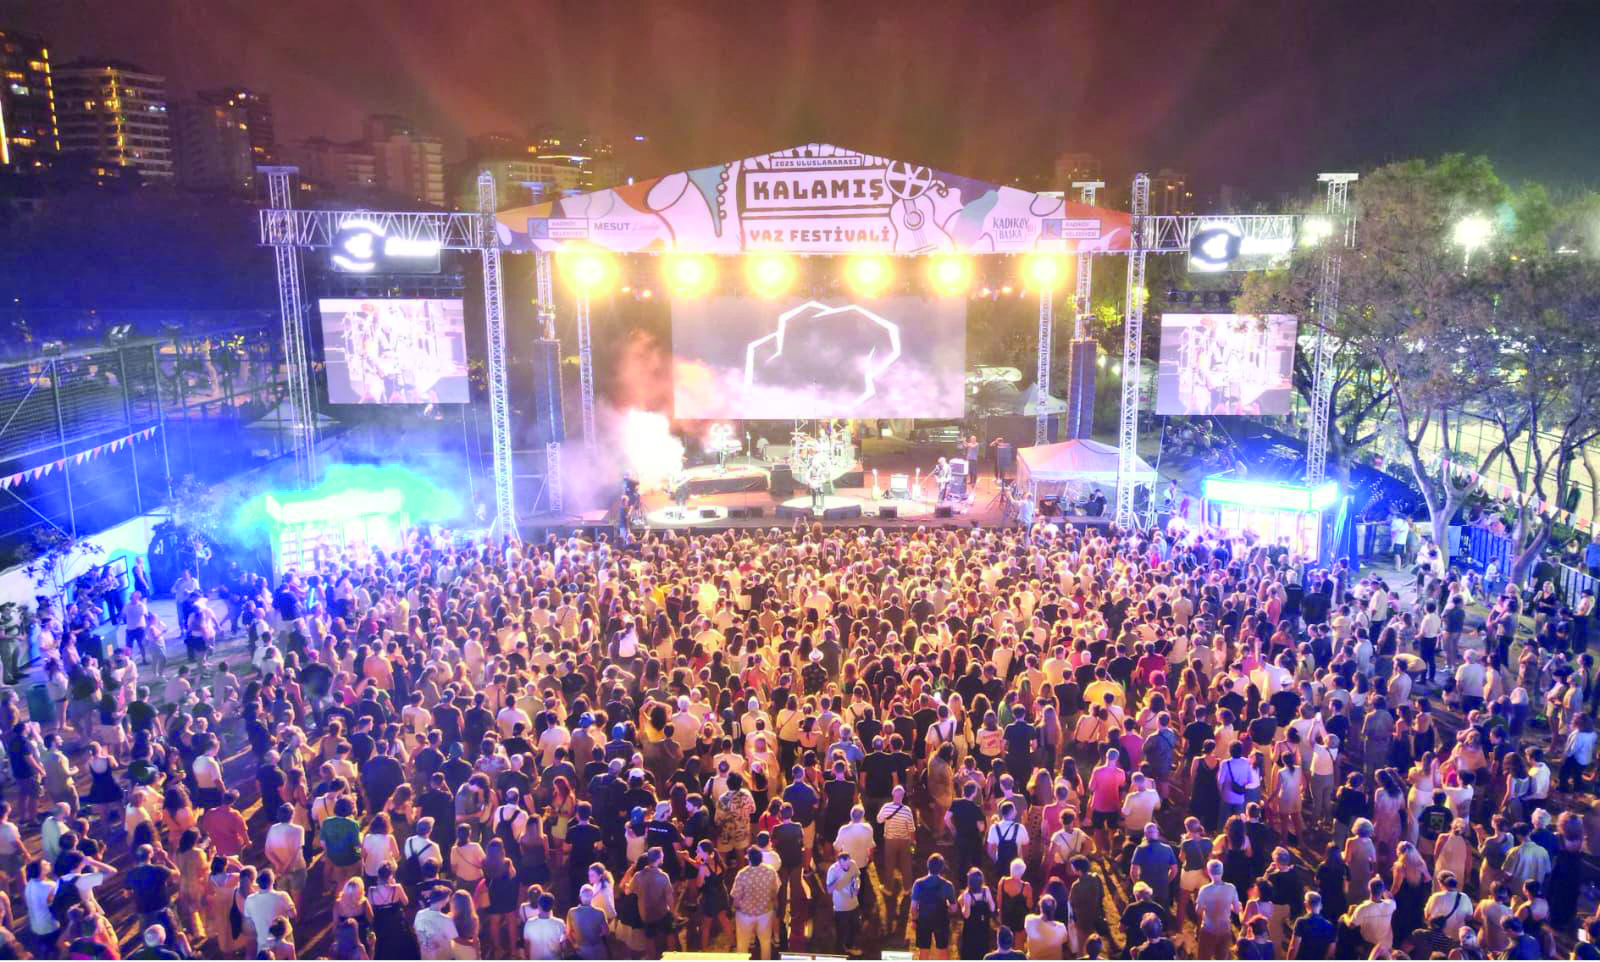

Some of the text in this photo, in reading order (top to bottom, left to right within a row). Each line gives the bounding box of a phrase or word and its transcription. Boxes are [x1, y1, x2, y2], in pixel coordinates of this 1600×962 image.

[753, 179, 884, 200] KALAMIŞ
[594, 222, 630, 231] MESUT
[750, 226, 889, 242] YAZ FESTİVALİ
